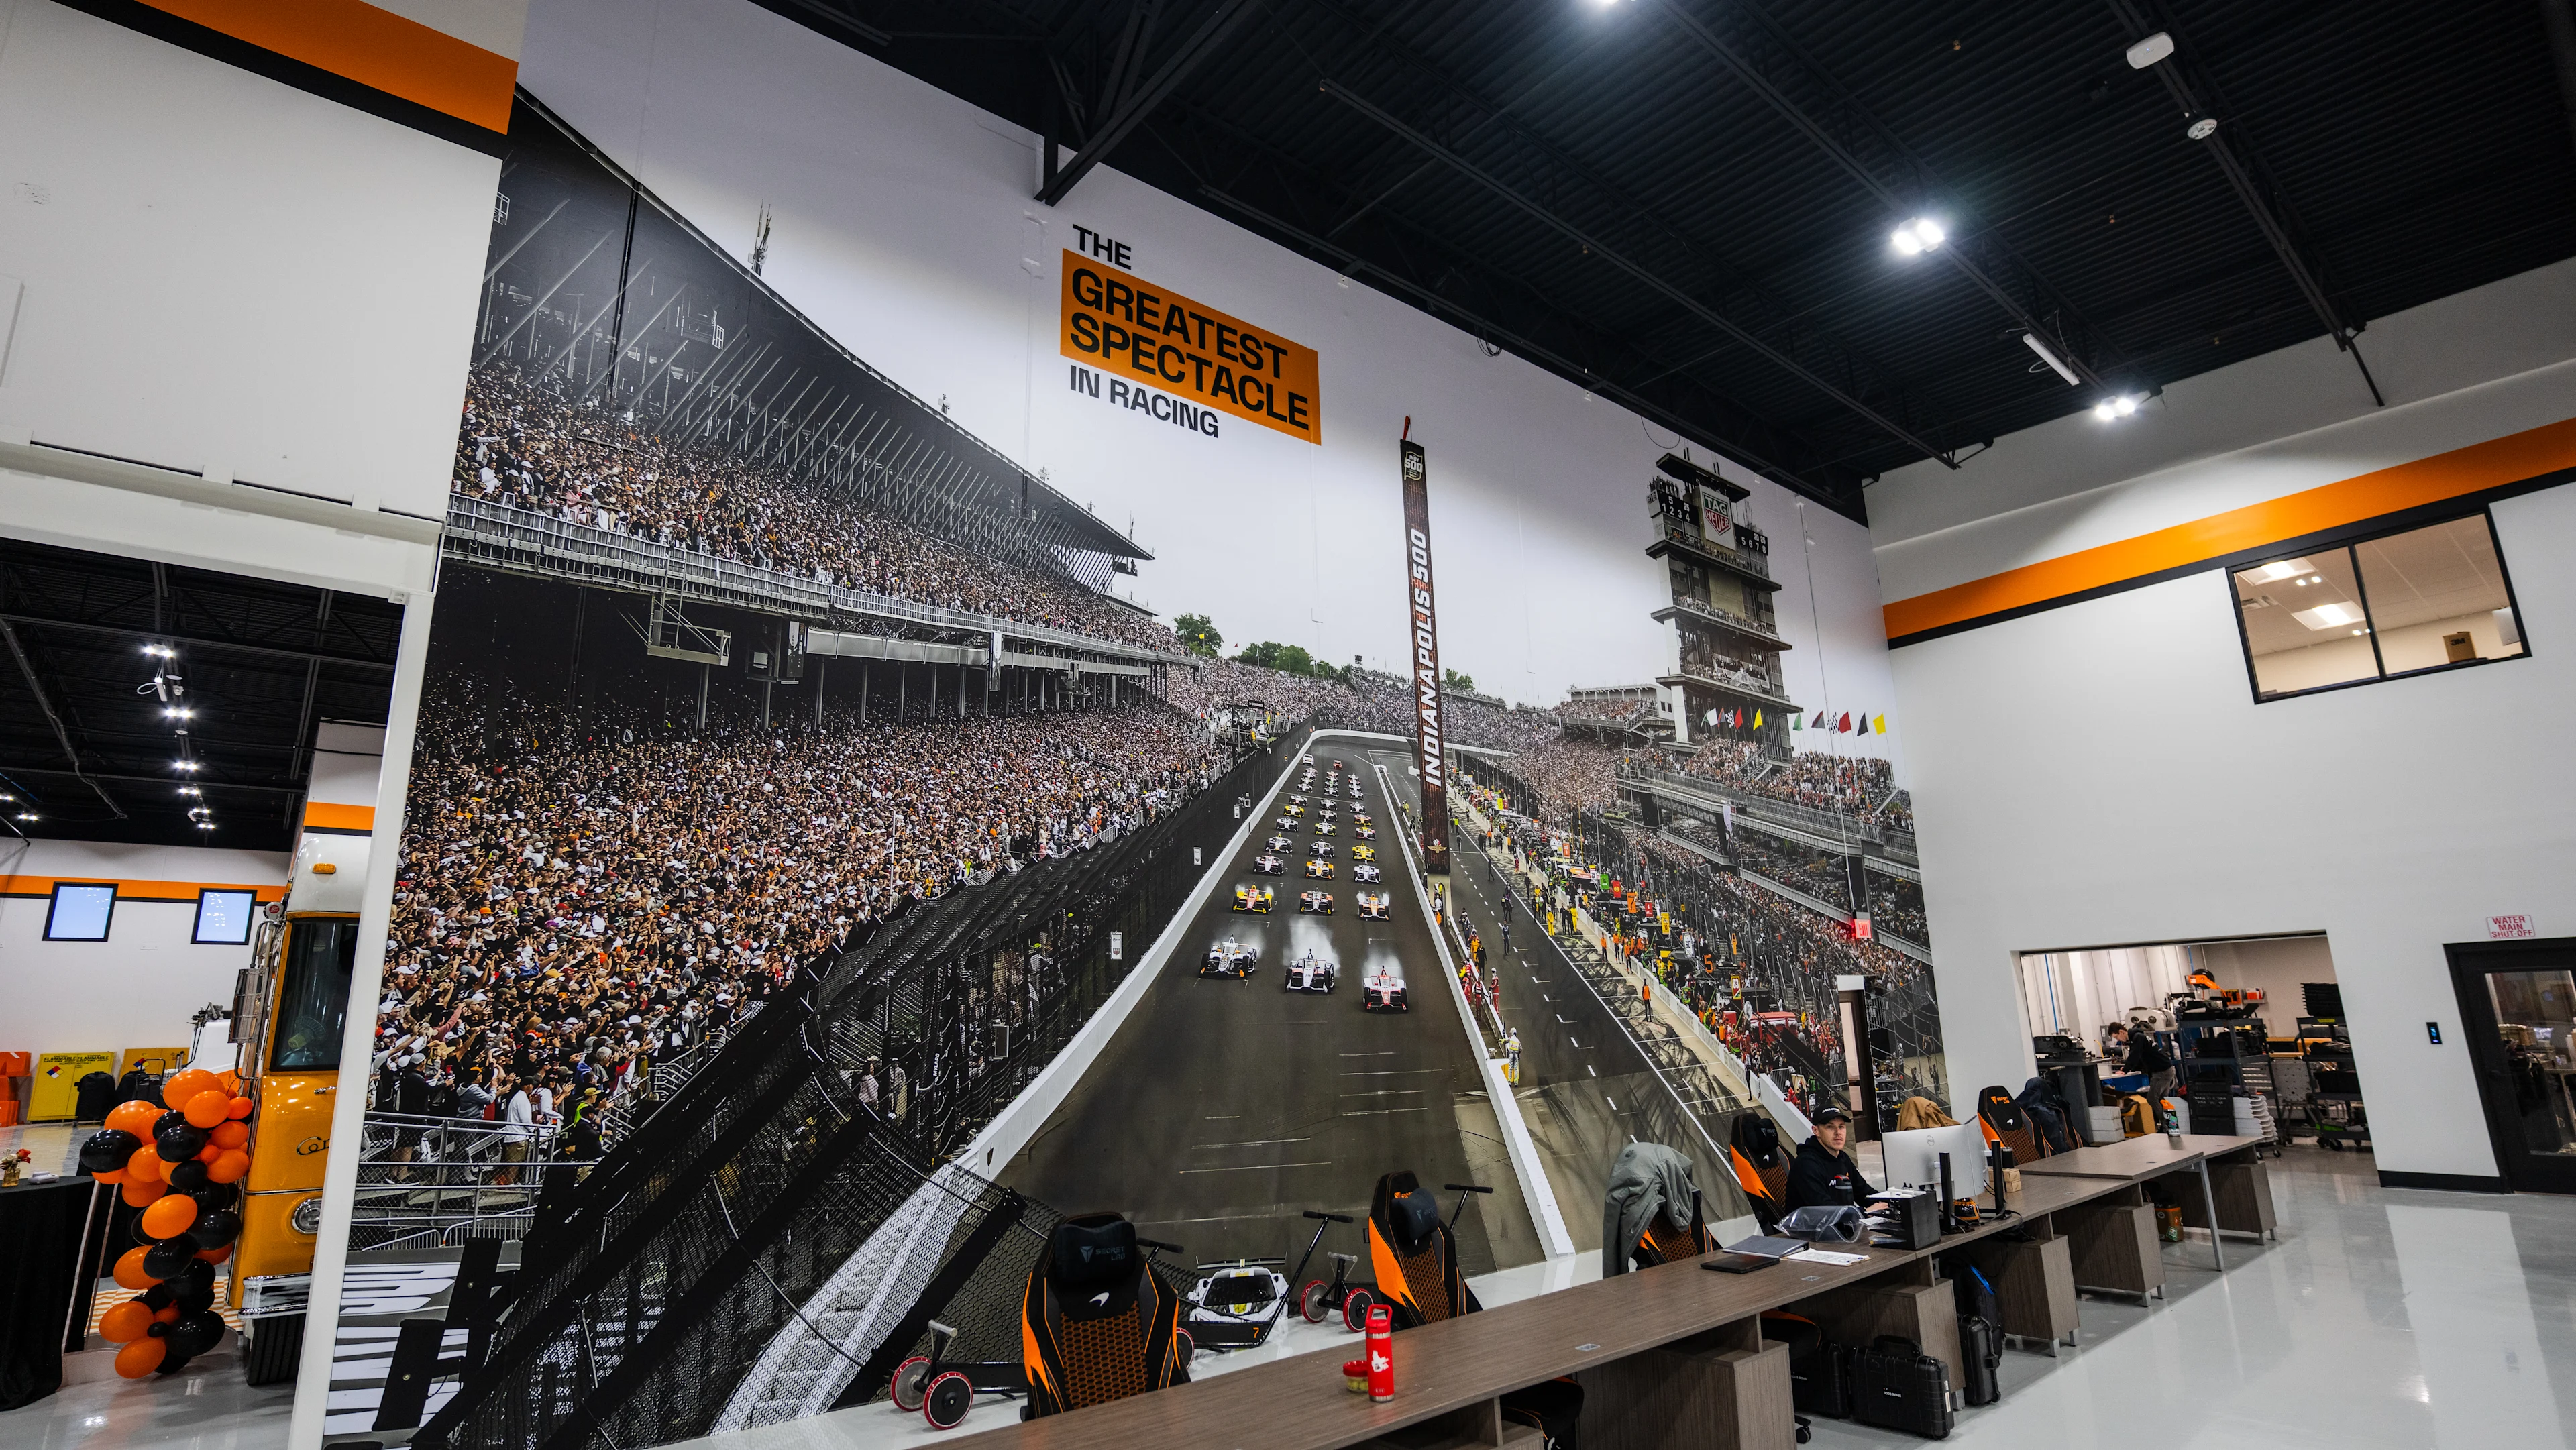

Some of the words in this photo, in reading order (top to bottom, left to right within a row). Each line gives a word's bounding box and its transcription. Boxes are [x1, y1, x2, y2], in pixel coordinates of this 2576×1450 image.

[1073, 223, 1132, 270] THE
[1072, 268, 1288, 379] GREATEST
[1070, 312, 1309, 431] SPECTACLE
[1070, 364, 1100, 399] IN
[1110, 378, 1219, 438] RACING
[1404, 458, 1423, 473] 500
[1409, 455, 1419, 463] INDY
[1704, 494, 1727, 516] TAG
[1705, 508, 1730, 532] HEUER
[1410, 528, 1429, 583] 500
[2451, 638, 2466, 646] 3M
[1414, 588, 1442, 787] INDIANAPOLIS
[1858, 922, 1869, 937] EXIT
[2492, 916, 2526, 925] WATER
[2491, 930, 2533, 938] SHUT-OFF
[1252, 1327, 1260, 1339] 7
